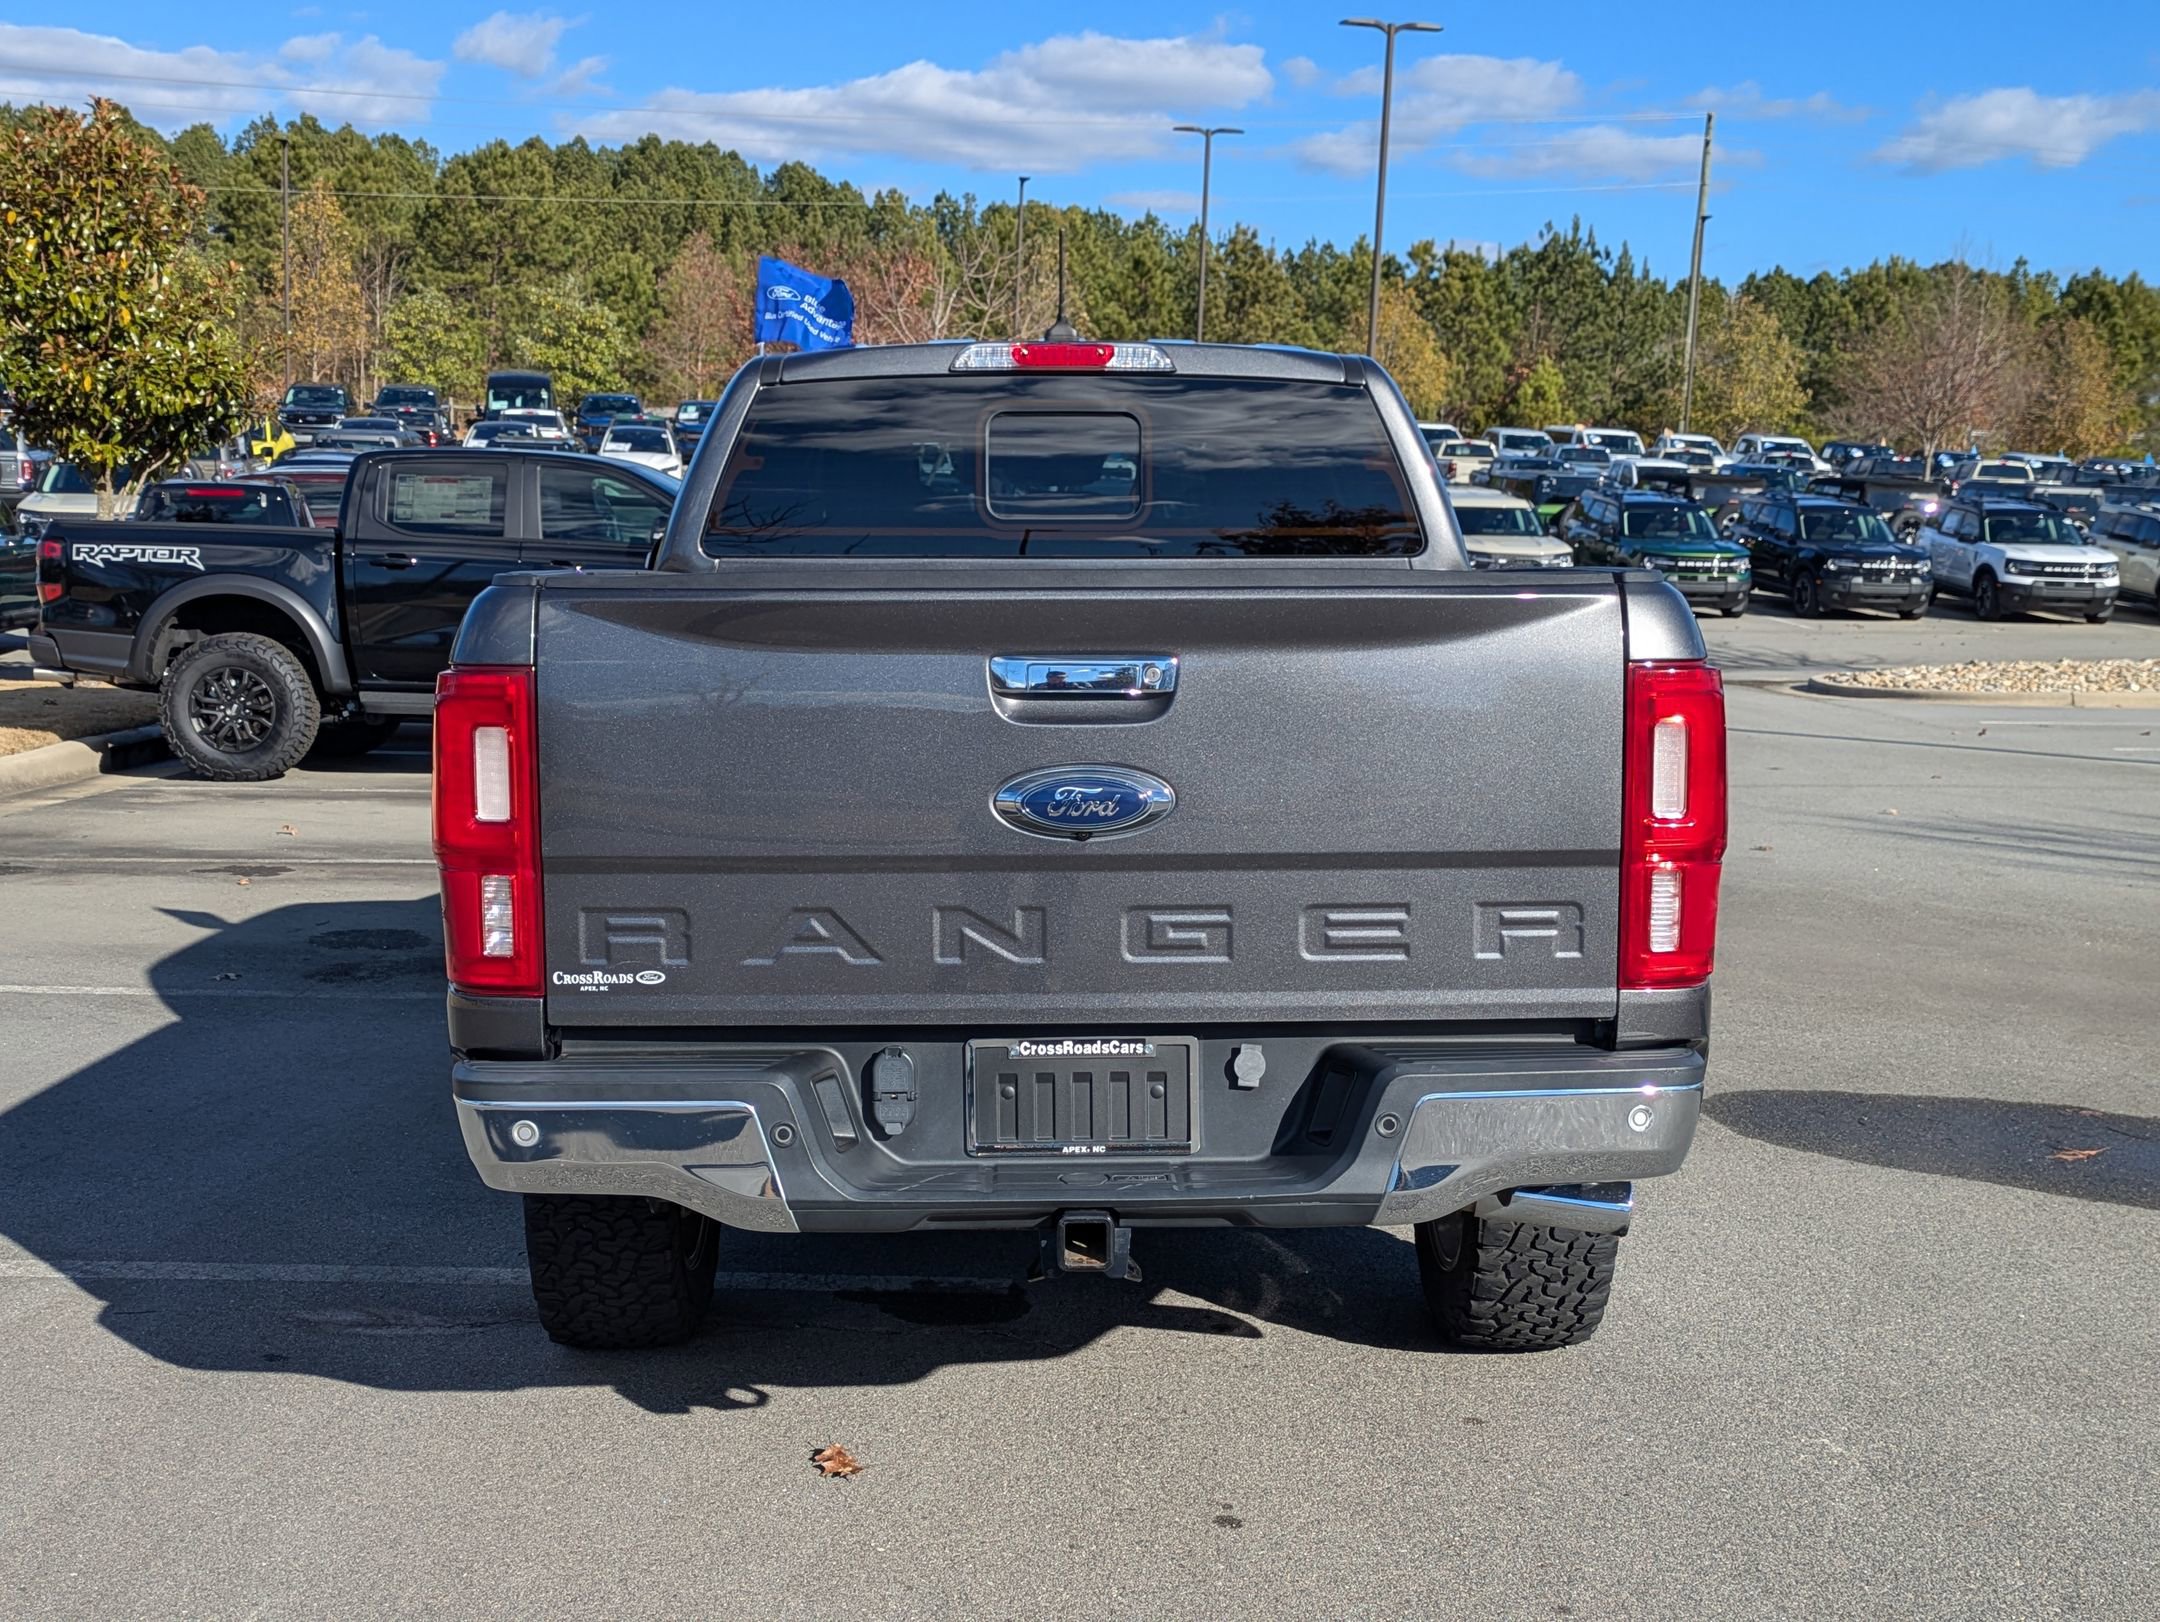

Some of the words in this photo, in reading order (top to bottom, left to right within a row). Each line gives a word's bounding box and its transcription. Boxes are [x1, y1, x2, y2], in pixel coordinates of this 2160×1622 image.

[72, 544, 206, 571] RAPTOR
[1047, 786, 1120, 817] Ford
[578, 901, 1584, 965] RANGER
[1020, 1040, 1144, 1056] CrossRoadsCars
[1092, 1145, 1106, 1153] NC
